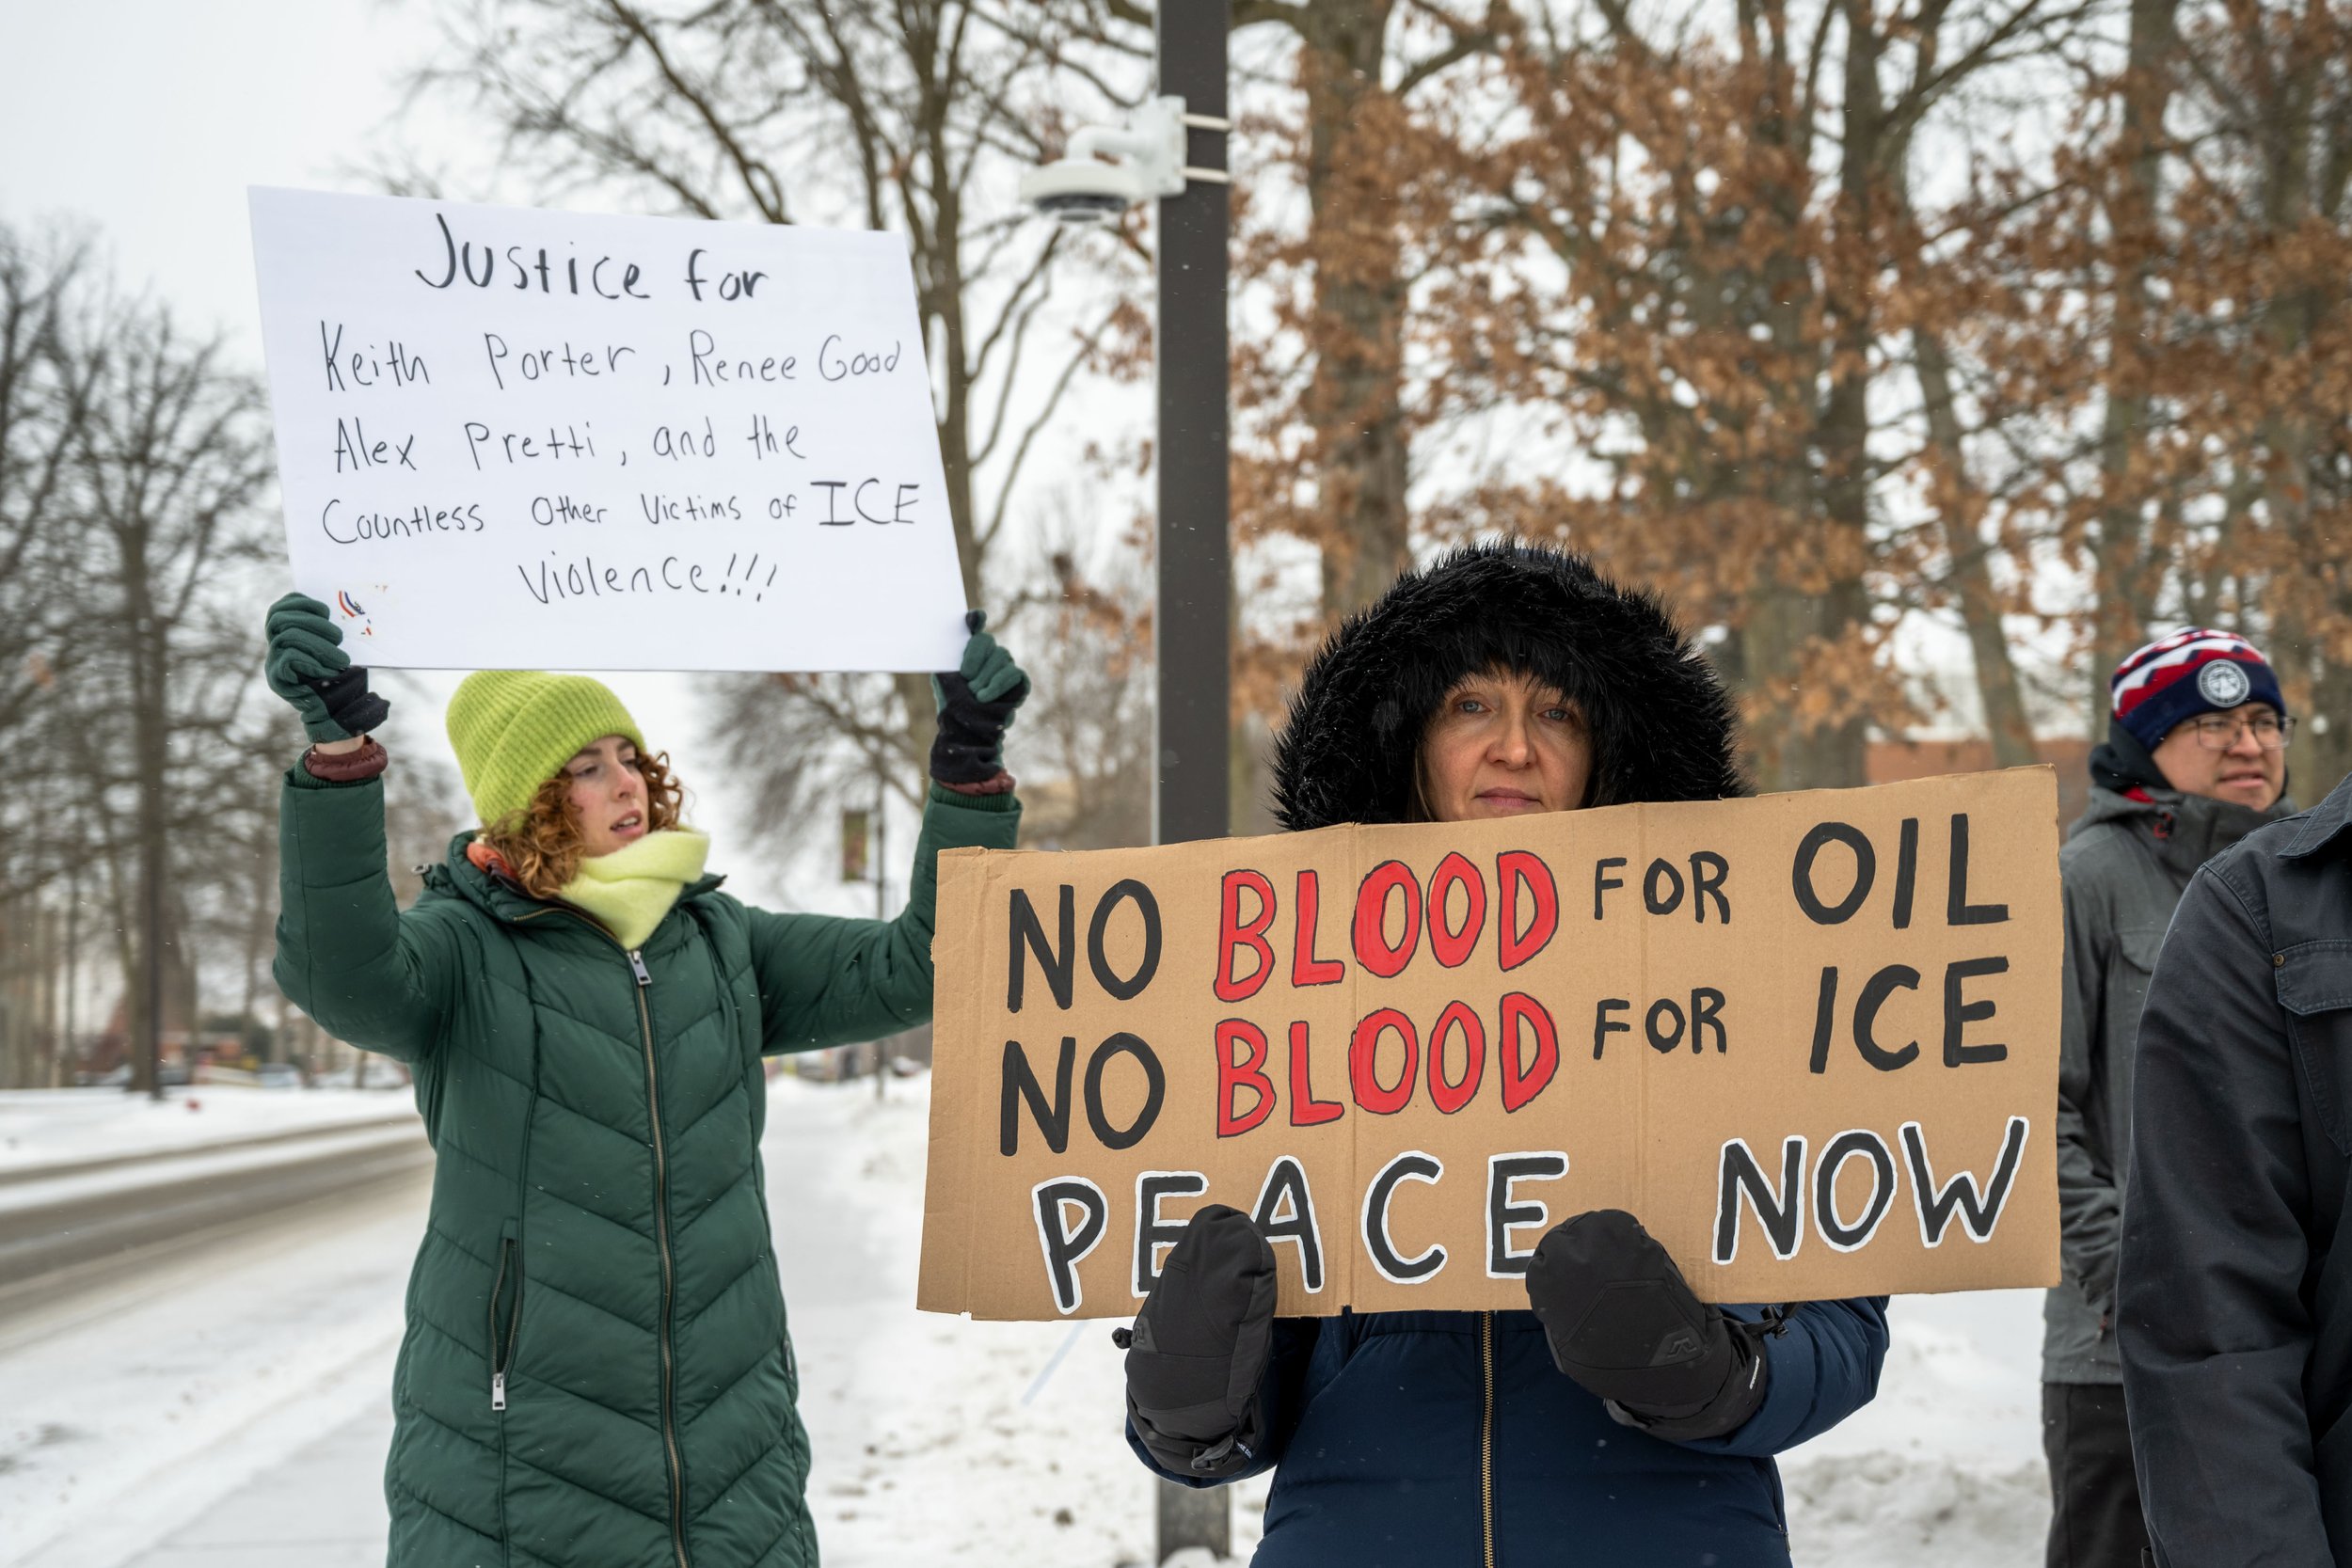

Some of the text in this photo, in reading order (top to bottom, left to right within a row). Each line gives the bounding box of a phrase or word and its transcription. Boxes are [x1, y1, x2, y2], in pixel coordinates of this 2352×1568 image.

[414, 212, 770, 303] Justice for
[320, 319, 431, 392] Keith
[689, 328, 797, 387] Renee
[818, 334, 900, 383] Good
[333, 416, 418, 475] Alex
[652, 417, 716, 461] and
[745, 413, 806, 460] the
[321, 477, 920, 546] Countless Other Victims of ICE
[1006, 812, 2010, 1013] NO BLOOD FOR OIL
[999, 955, 2010, 1158] NO BLOOD FOR ICE
[1031, 1115, 2030, 1315] PEACE NOW
